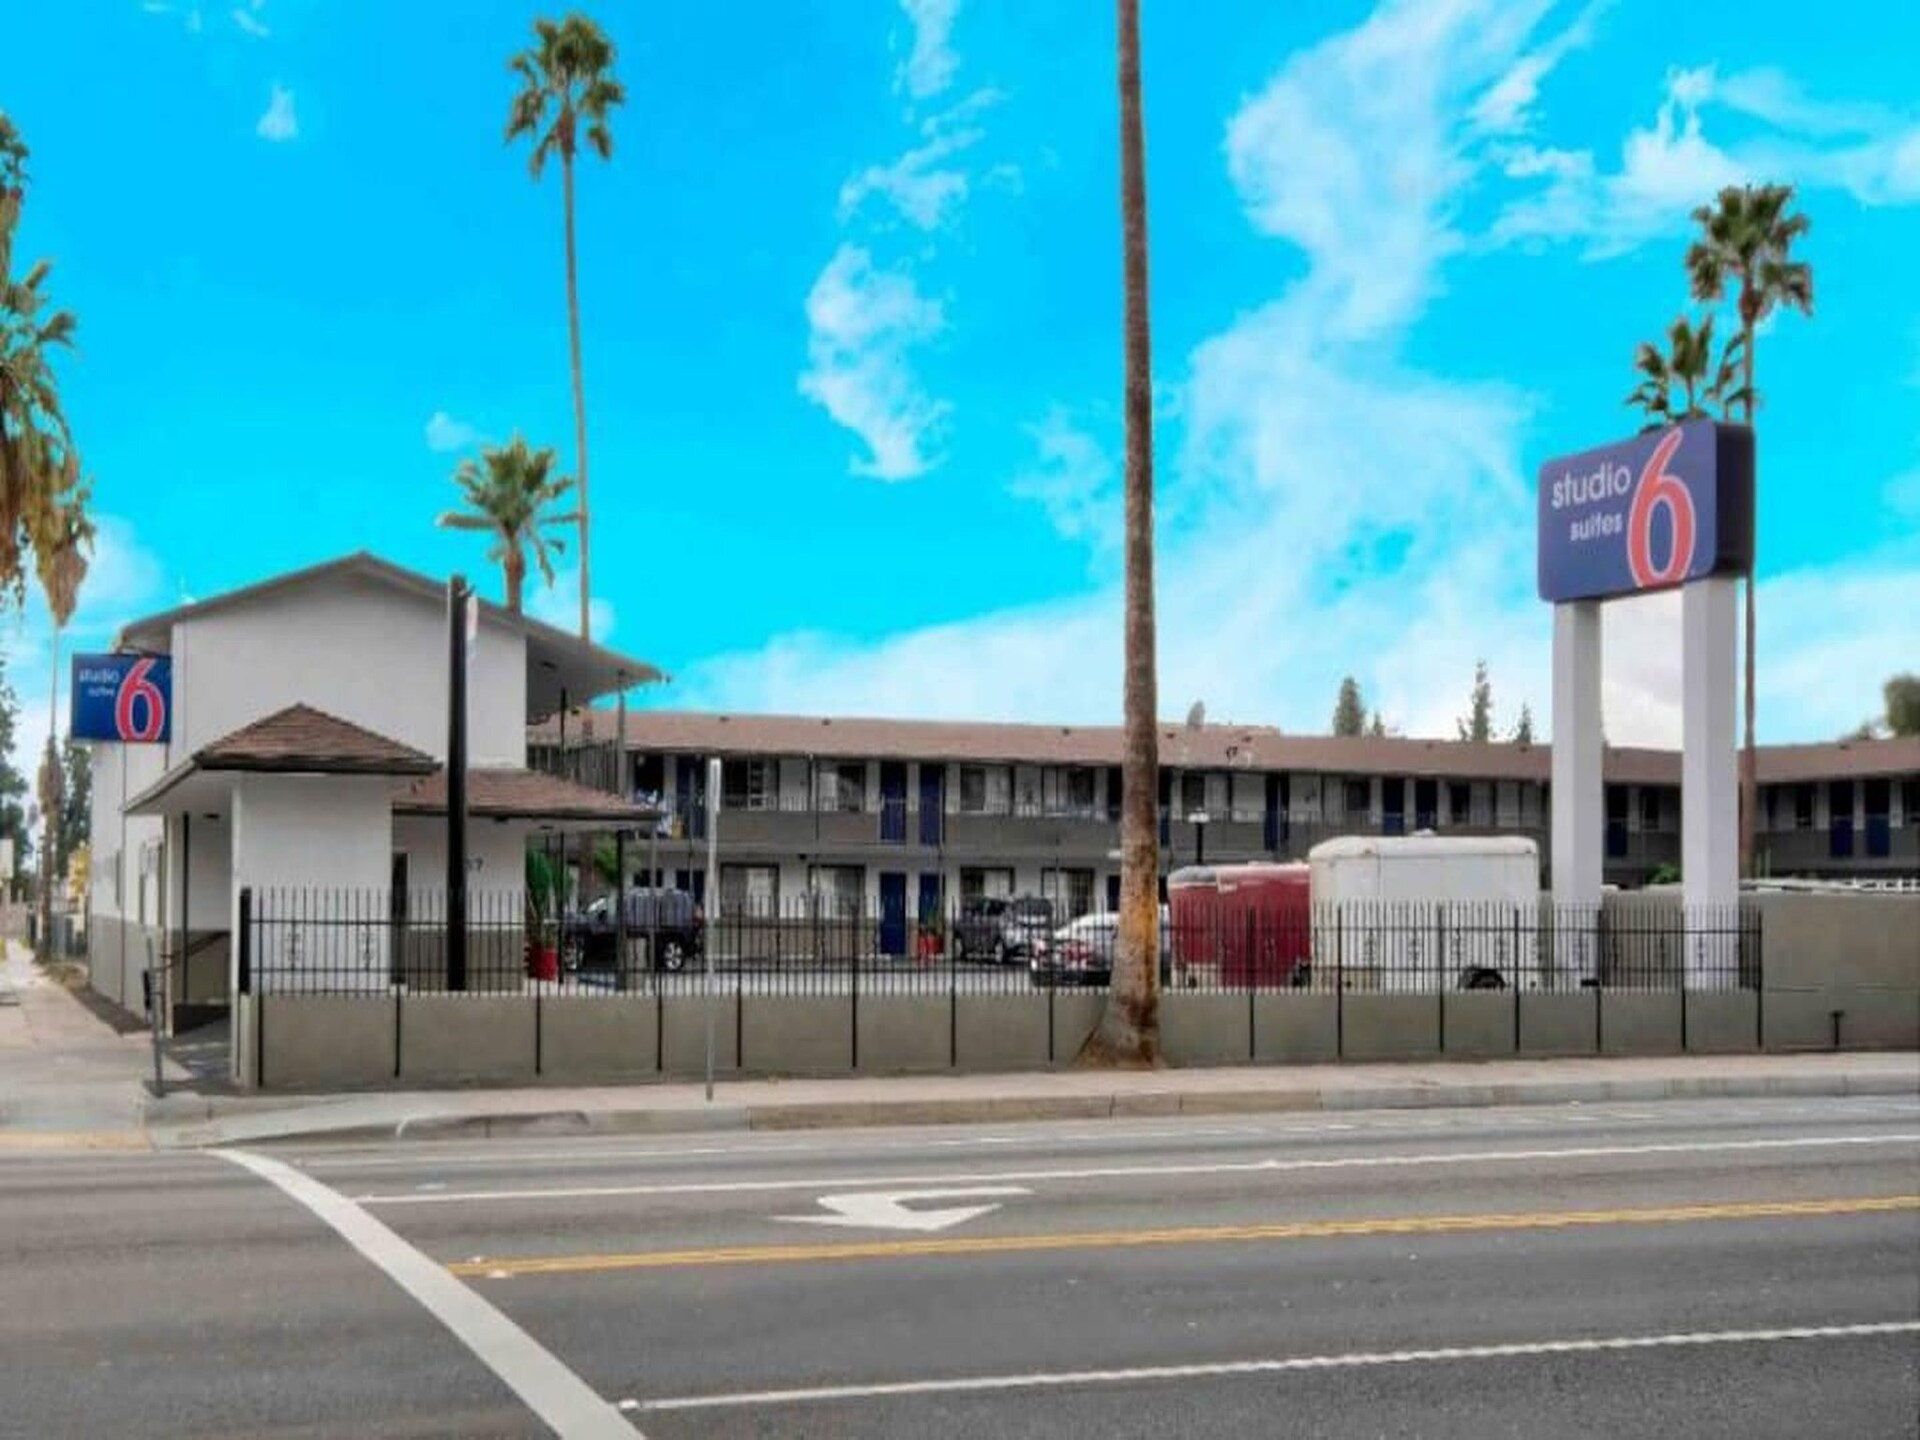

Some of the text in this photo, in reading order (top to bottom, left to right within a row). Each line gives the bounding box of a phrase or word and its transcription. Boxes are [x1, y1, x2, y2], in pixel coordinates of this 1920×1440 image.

[1552, 462, 1631, 508] studio
[1627, 426, 1696, 590] 6
[1570, 511, 1622, 541] suites
[115, 657, 166, 741] 6
